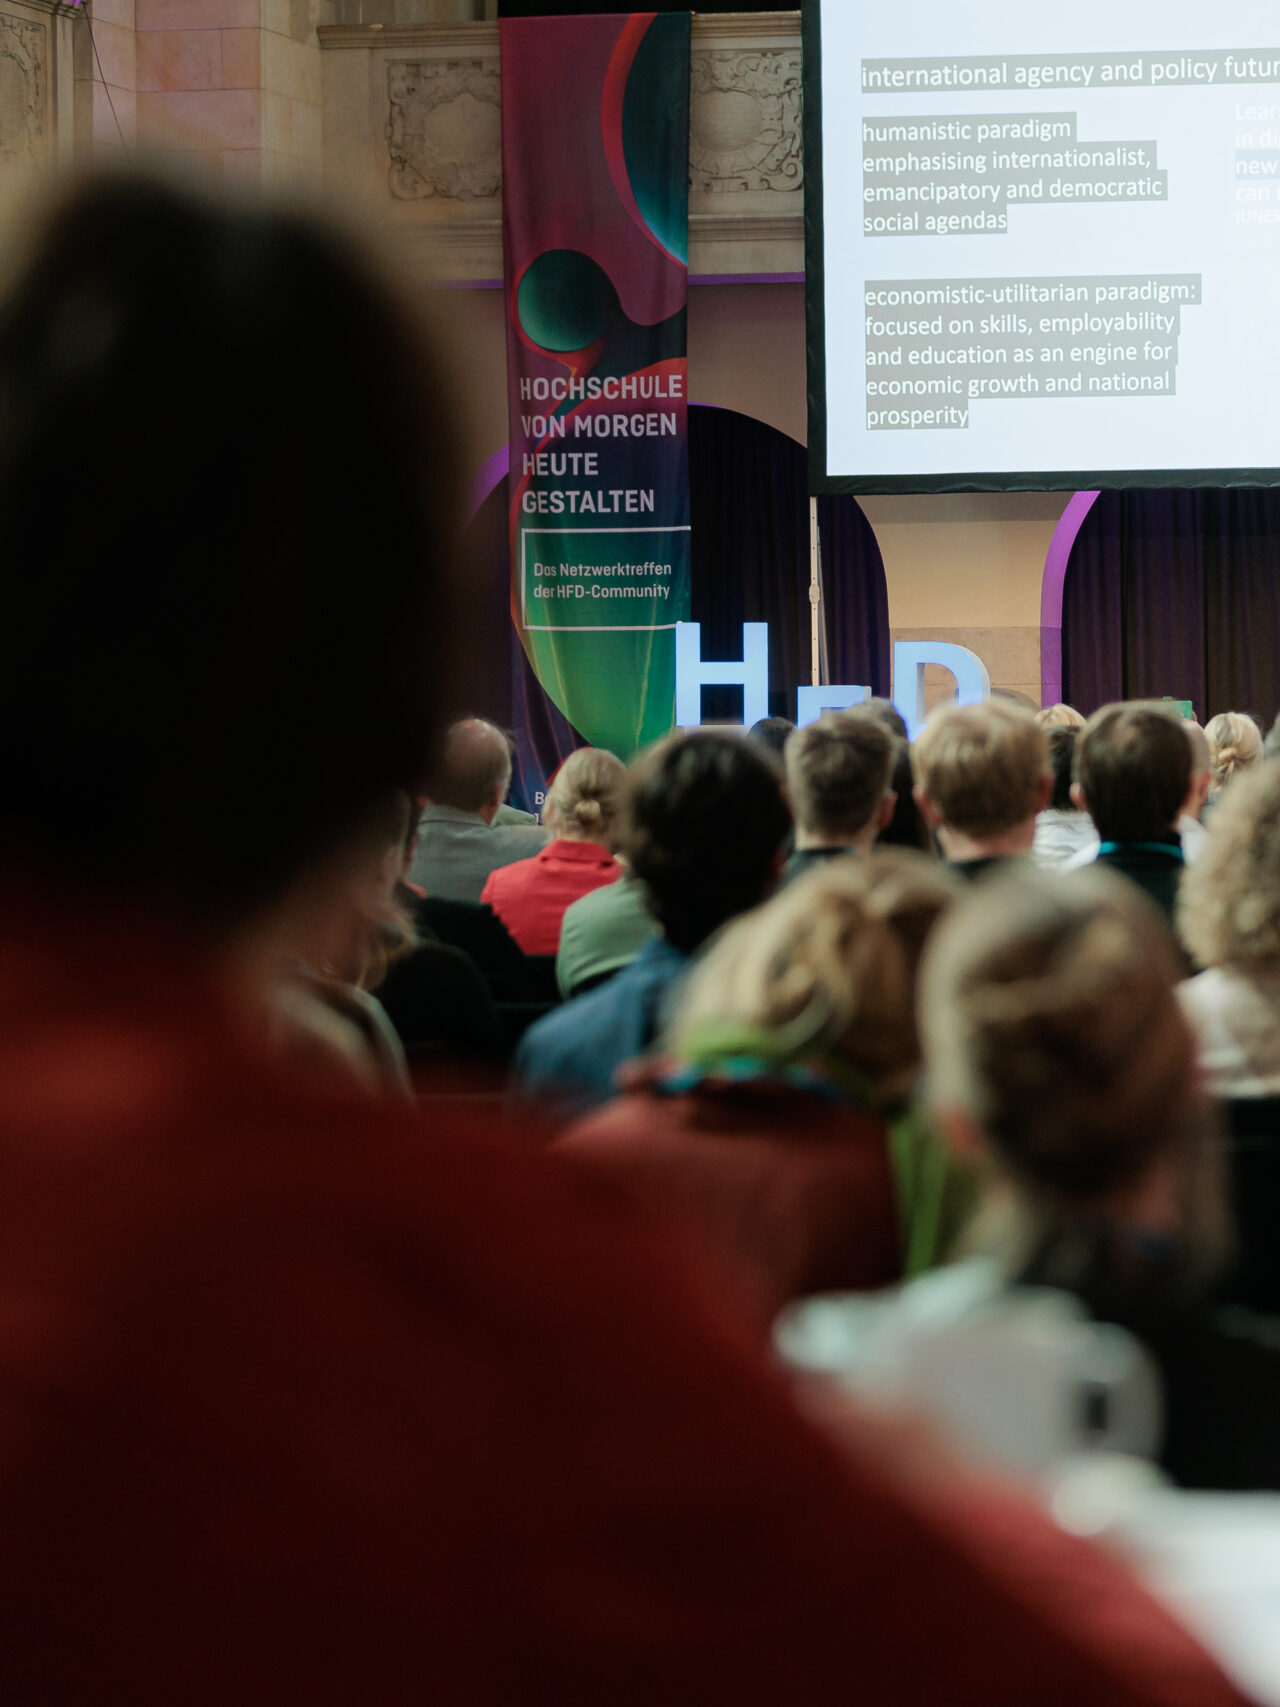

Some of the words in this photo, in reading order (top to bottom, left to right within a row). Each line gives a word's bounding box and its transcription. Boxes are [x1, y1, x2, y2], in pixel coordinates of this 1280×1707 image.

[862, 63, 1007, 87] international
[1014, 61, 1095, 87] agency
[1100, 59, 1143, 82] and
[1151, 57, 1217, 84] policy
[863, 121, 971, 142] humanistic
[977, 119, 1070, 142] paradigm
[1235, 132, 1253, 148] in
[863, 150, 986, 174] emphasising
[992, 146, 1151, 169] internationalist,
[1236, 160, 1278, 174] new
[864, 179, 1001, 204] emancipatory
[1007, 178, 1043, 199] and
[1049, 176, 1162, 198] democratic
[1235, 186, 1270, 201] can
[864, 212, 918, 232] social
[925, 210, 1007, 234] agendas
[865, 283, 1088, 306] economistic-utilitarian
[1095, 282, 1196, 303] paradigm:
[865, 315, 942, 336] focused
[949, 318, 974, 334] on
[980, 313, 1033, 335] skills,
[1039, 311, 1175, 335] employability
[866, 345, 901, 366] and
[908, 343, 1007, 364] education
[1013, 347, 1034, 363] as
[1040, 346, 1064, 362] an
[1070, 342, 1137, 365] engine
[1143, 340, 1172, 360] for
[520, 375, 682, 400] HOCHSCHULE
[866, 375, 962, 395] economic
[968, 374, 1038, 397] growth
[1045, 371, 1081, 392] and
[1088, 370, 1169, 391] national
[521, 415, 565, 438] VON
[574, 413, 676, 437] MORGEN
[867, 405, 968, 428] prosperity
[523, 453, 598, 476] HEUTE
[522, 489, 654, 513] GESTALTEN
[534, 563, 556, 576] Das
[560, 562, 671, 576] Netzwerktreffen
[534, 584, 554, 598] der
[557, 584, 670, 599] HFD-Community
